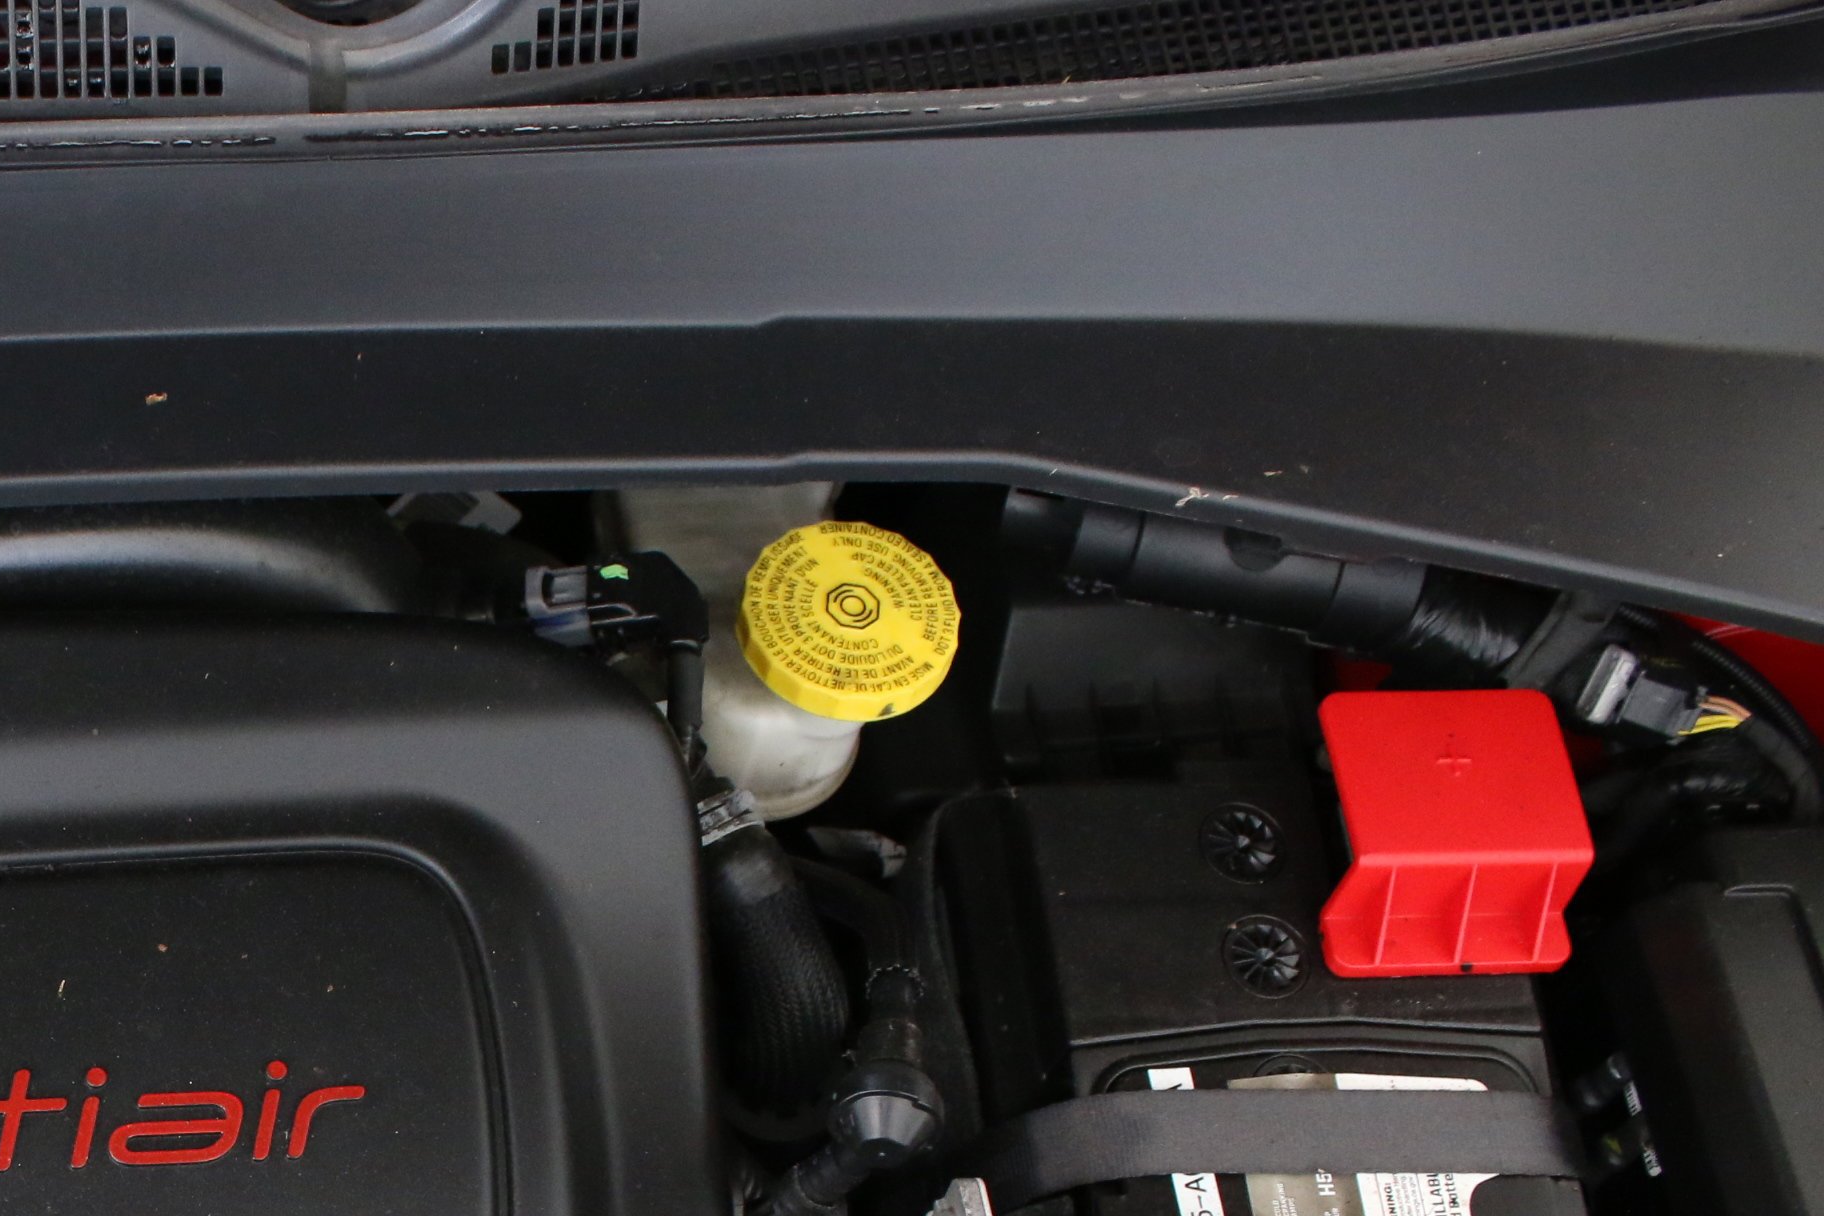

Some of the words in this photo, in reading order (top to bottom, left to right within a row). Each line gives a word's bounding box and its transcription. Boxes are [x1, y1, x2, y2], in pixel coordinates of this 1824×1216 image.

[818, 523, 885, 540] CONTAINER
[833, 536, 863, 548] ONLY
[752, 531, 803, 582] REMPLISSAGE
[851, 552, 875, 564] CAP
[867, 541, 890, 556] USE
[887, 534, 927, 562] SEALED
[767, 546, 808, 601] UNIQUEMENT
[794, 558, 820, 578] D'UN
[877, 559, 911, 588] FILLER
[750, 585, 763, 599] DE
[863, 568, 905, 609] WARNING
[929, 571, 953, 598] FROM
[783, 577, 807, 637] PROVENANT
[907, 587, 923, 621] CLEAN
[943, 600, 956, 628] FLUID
[751, 601, 779, 649] BOUCHON
[923, 603, 939, 642] BEFORE
[807, 620, 880, 651] CONTENANT
[934, 636, 951, 656] DOT
[773, 648, 790, 662] LE
[812, 643, 837, 660] DOT
[838, 652, 887, 666] LIQUIDE
[887, 644, 904, 658] DU
[786, 659, 846, 690] NETTOYER
[845, 668, 860, 679] LE
[863, 669, 879, 680] DE
[882, 655, 915, 678] AVANT
[908, 661, 935, 681] MISE
[893, 675, 910, 688] EN
[1444, 1173, 1462, 1209] Batte
